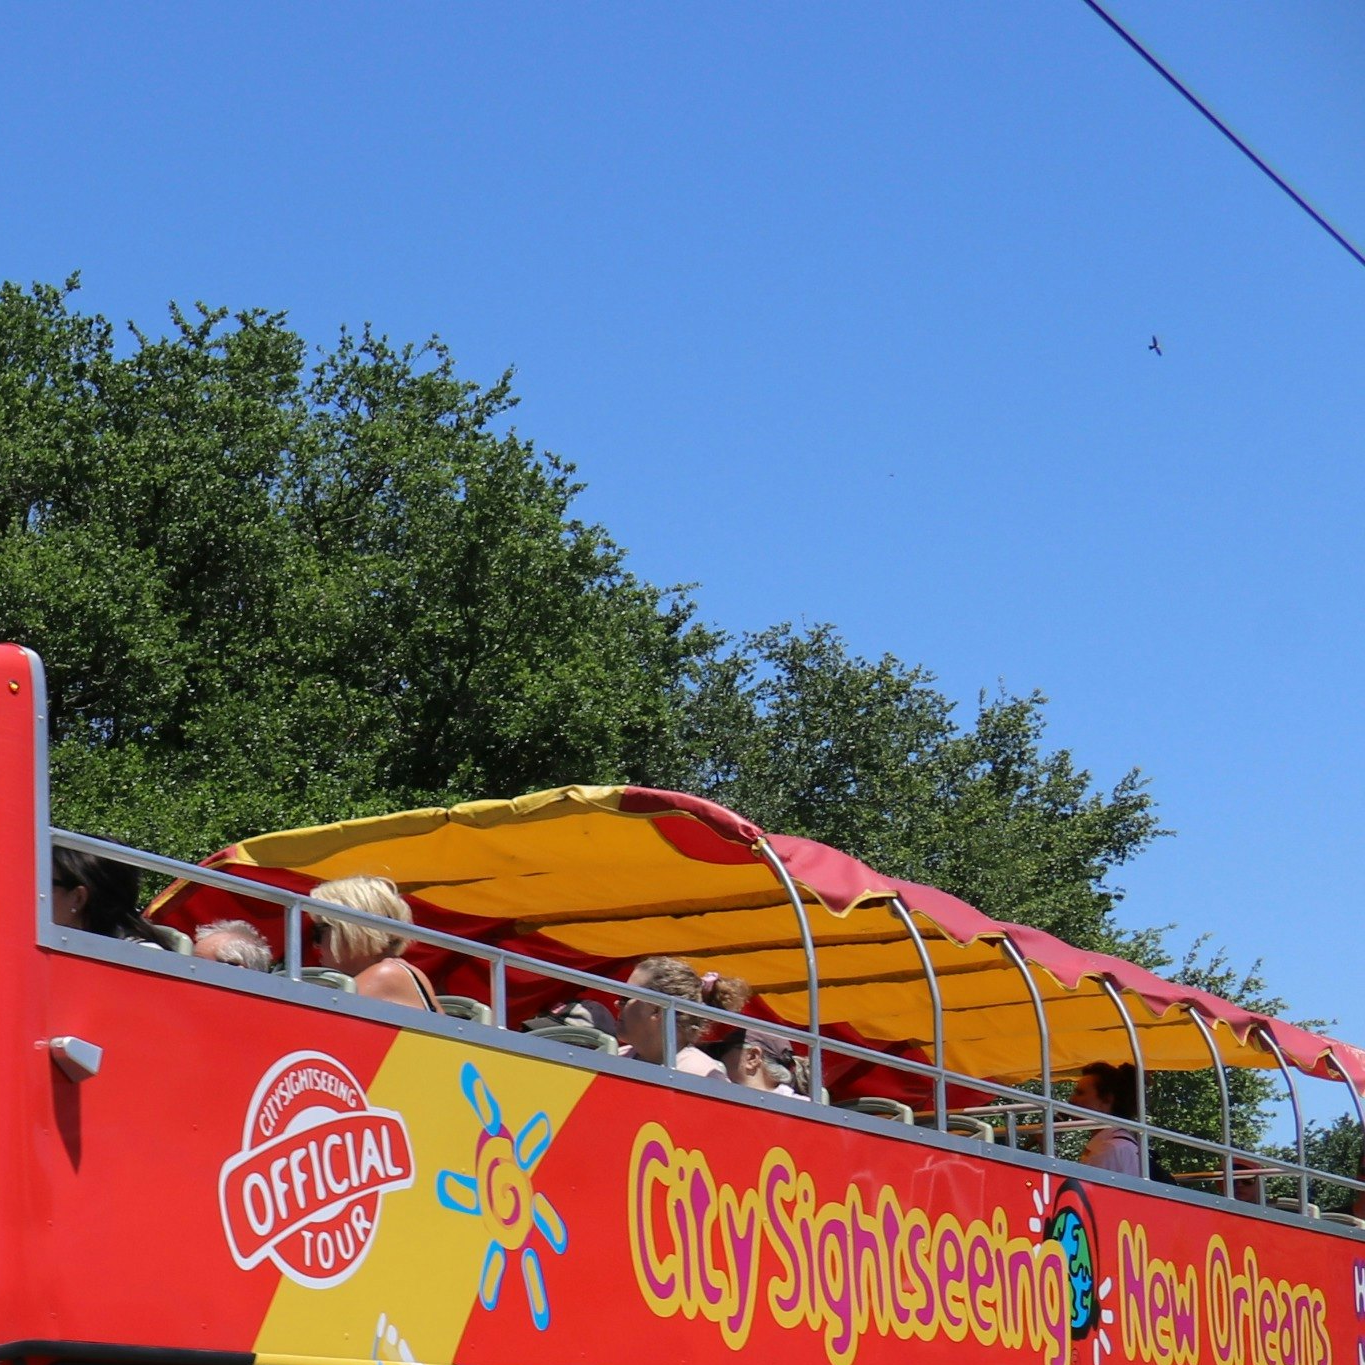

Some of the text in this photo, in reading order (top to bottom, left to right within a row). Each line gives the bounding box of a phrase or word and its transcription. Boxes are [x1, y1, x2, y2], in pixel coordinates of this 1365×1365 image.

[258, 1067, 358, 1137] CITYSIGHTSEEING
[242, 1124, 405, 1237] OFFICIAL
[300, 1204, 373, 1270] TOUR
